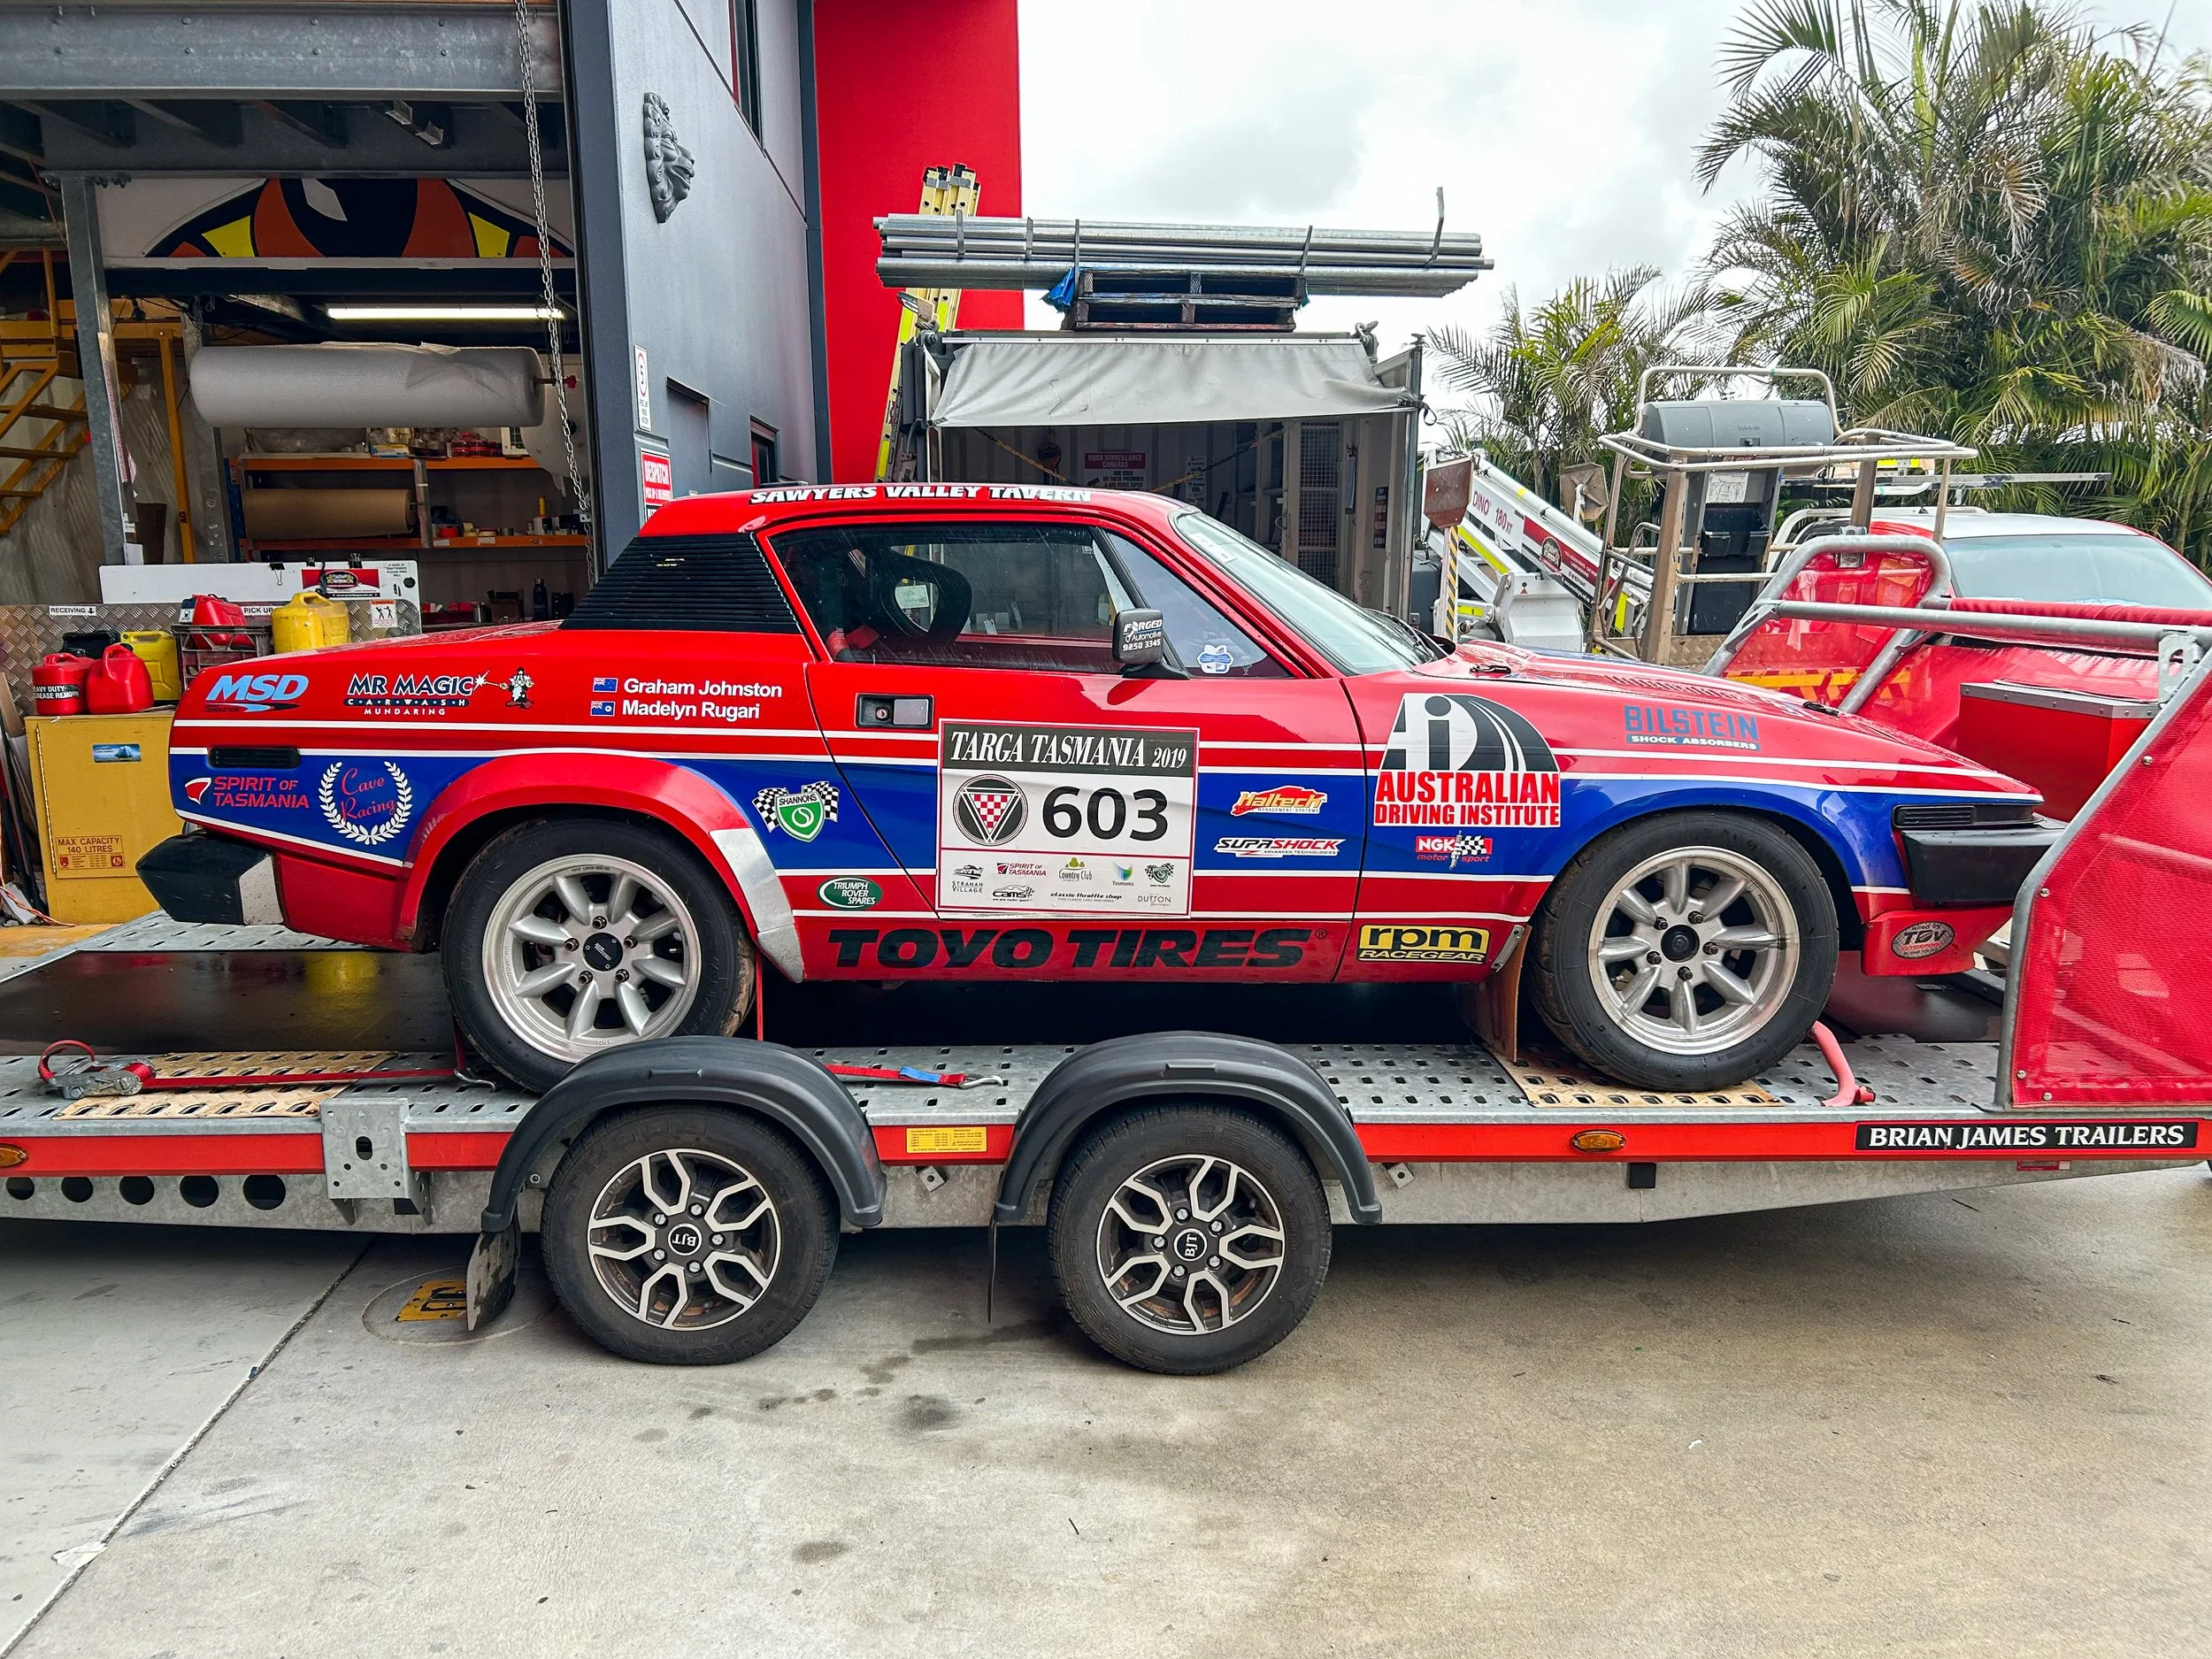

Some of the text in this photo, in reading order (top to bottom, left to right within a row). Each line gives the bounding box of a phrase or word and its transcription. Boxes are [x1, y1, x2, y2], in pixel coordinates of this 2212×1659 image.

[748, 486, 1093, 505] SAWYERS VALLEY TAVERN
[1472, 491, 1490, 515] DINO
[1122, 639, 1161, 651] 9250 3345
[1131, 631, 1162, 641] Automotive
[205, 674, 309, 701] MSD
[347, 672, 474, 696] MR MAGIC
[624, 678, 782, 698] Graham Johnston
[622, 699, 761, 722] Madelyn Rugari
[1624, 704, 1759, 741] BILSTEIN
[950, 731, 1187, 769] TARGA TASMANIA 2019
[1631, 735, 1757, 750] SHOCK ABSORBERS
[213, 775, 298, 790] SPIRIT OF
[341, 767, 386, 795] Cave
[1376, 771, 1560, 803] AUSTRALIAN
[213, 792, 310, 809] TASMANIA
[779, 793, 818, 806] SHANNONS
[1238, 791, 1322, 809] Haltech
[341, 796, 397, 822] Racing
[1041, 786, 1169, 842] 603
[1375, 804, 1560, 826] DRIVING INSTITUTE
[80, 837, 119, 846] CAPACITY
[1217, 839, 1340, 850] SUPASHOCK
[1417, 838, 1456, 853] NGK
[1461, 854, 1490, 863] sport
[1058, 869, 1093, 881] Country Club
[833, 881, 868, 890] TRIUMPH
[992, 890, 1027, 899] cams
[848, 896, 875, 905] SPARES
[827, 928, 1056, 969] TOYO
[1368, 927, 1483, 952] rpm
[1359, 950, 1486, 962] RACEGEAR
[1868, 1124, 2185, 1149] BRIAN JAMES TRAILERS
[672, 1233, 697, 1248] BJT
[1184, 1233, 1198, 1257] BJT
